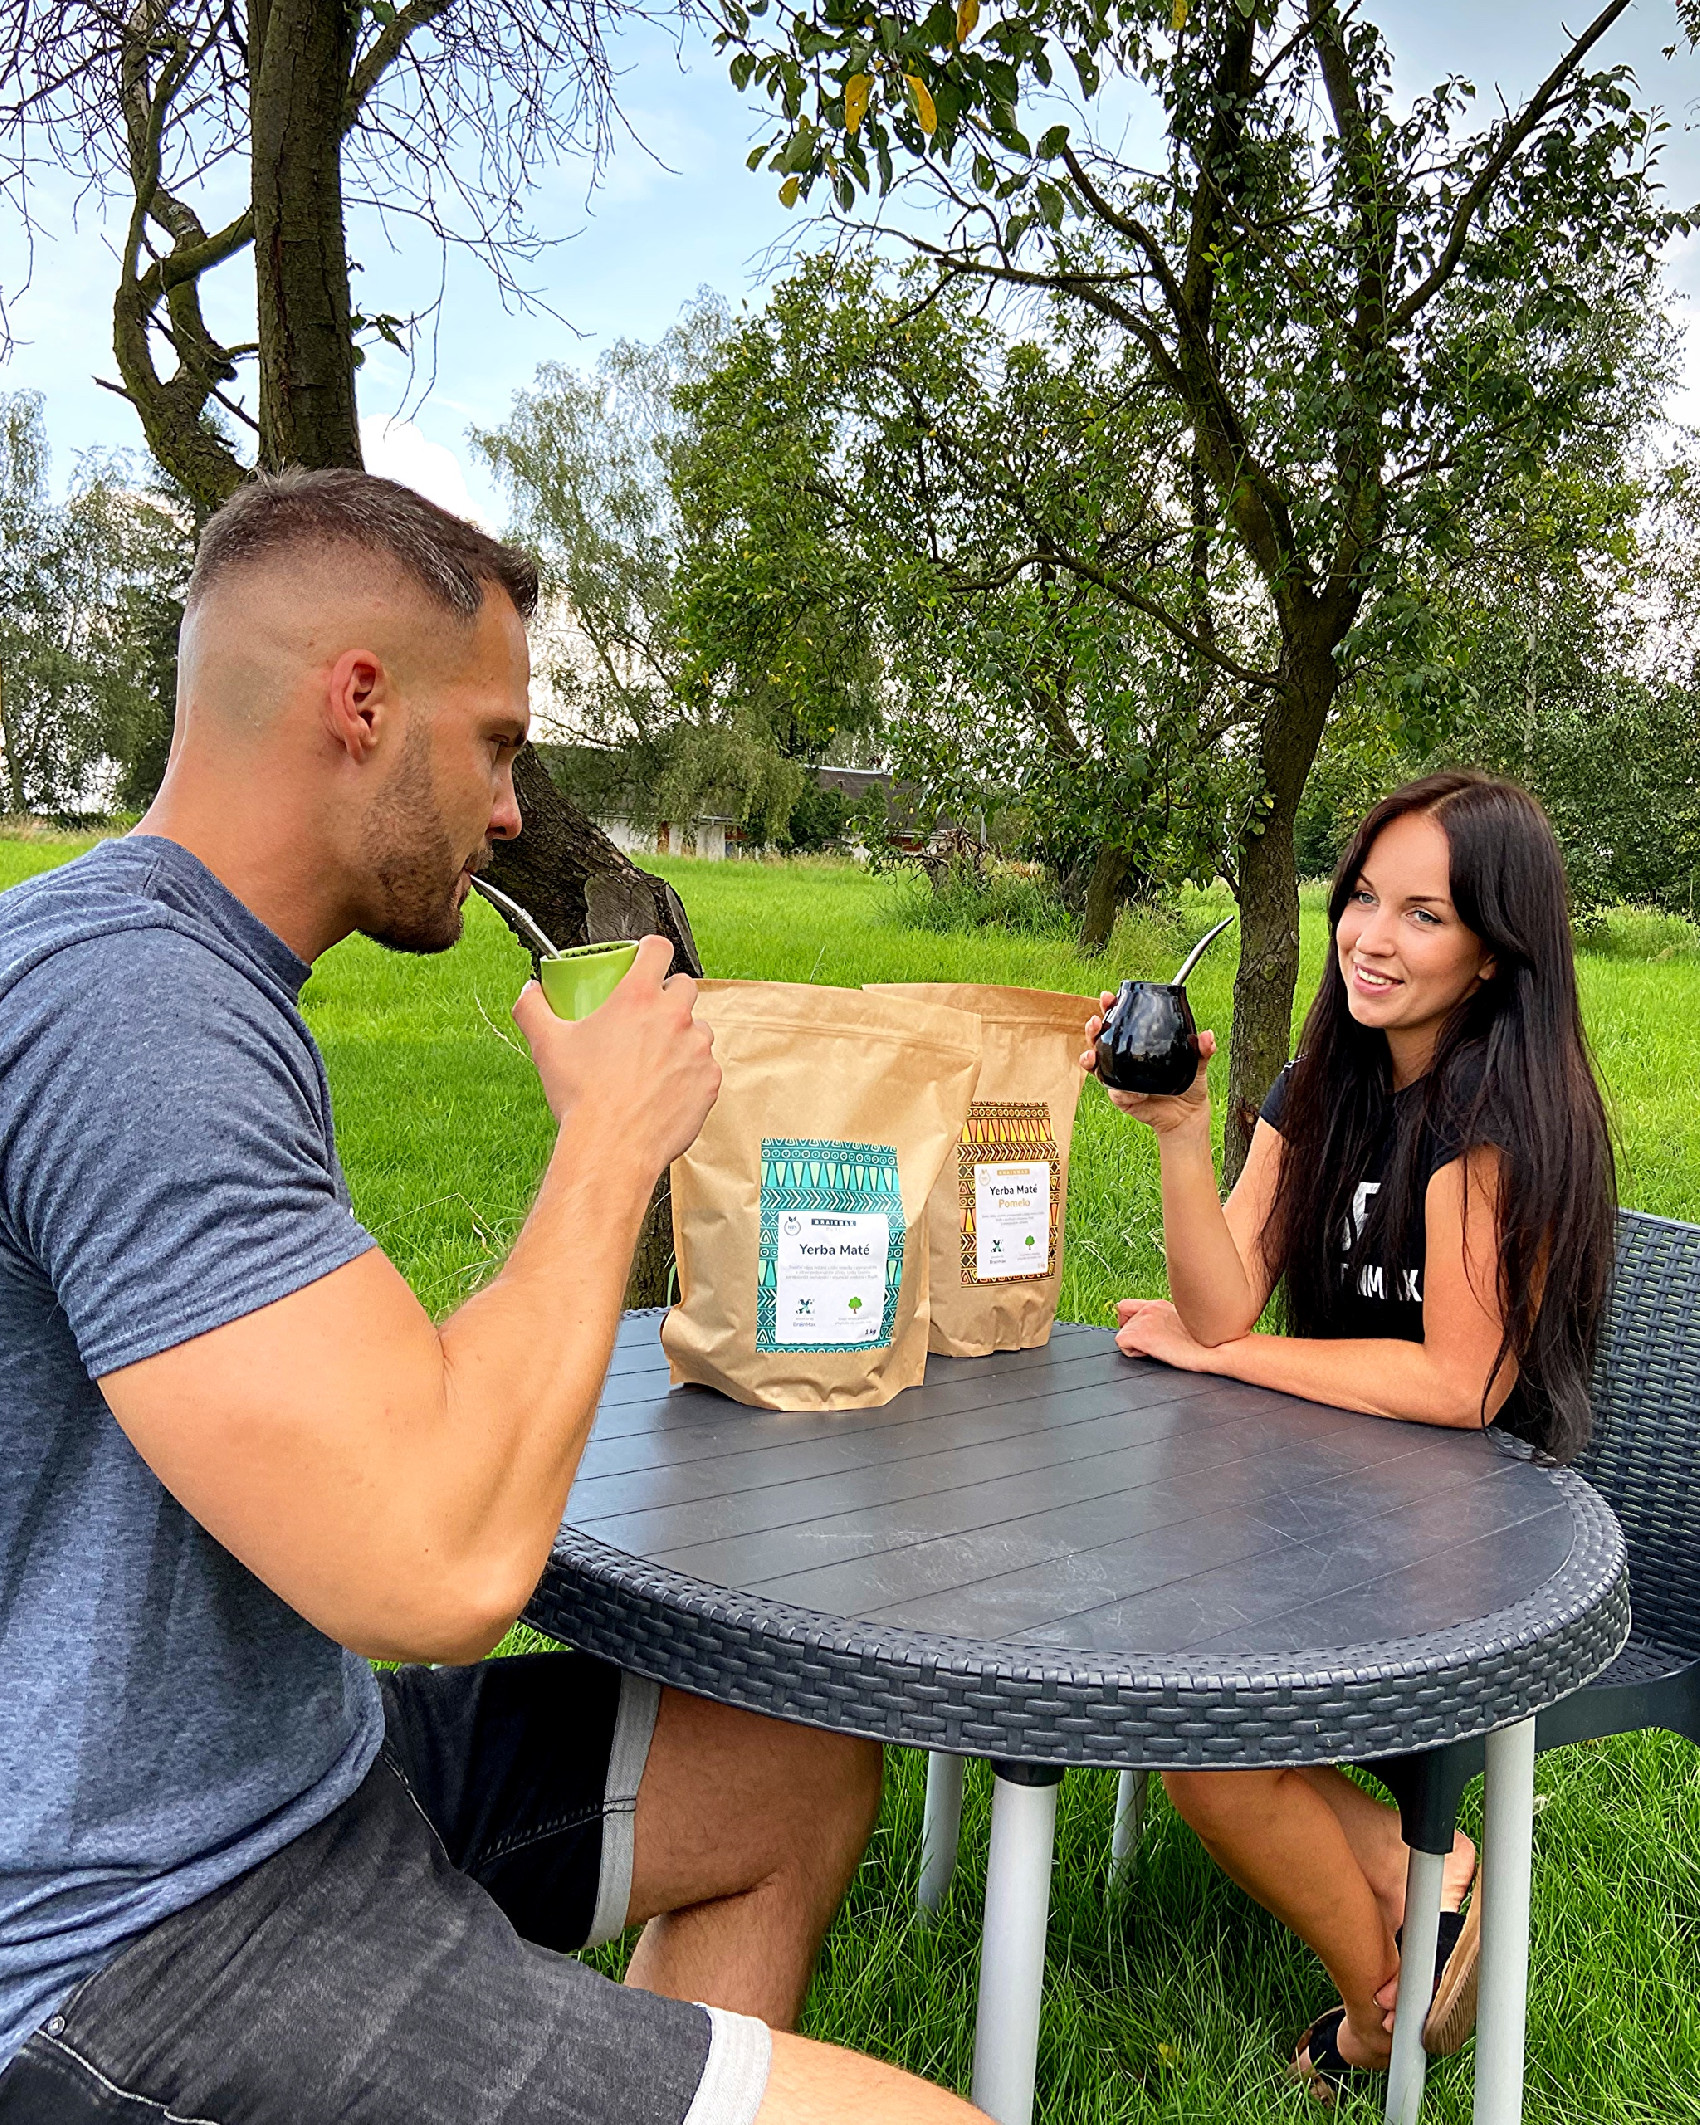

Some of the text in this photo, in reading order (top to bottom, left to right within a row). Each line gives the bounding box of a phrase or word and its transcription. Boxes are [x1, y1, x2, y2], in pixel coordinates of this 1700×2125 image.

[990, 1184, 1038, 1196] Yerba Maté
[998, 1198, 1031, 1208] Pomelo
[799, 1243, 870, 1255] Yerba Maté
